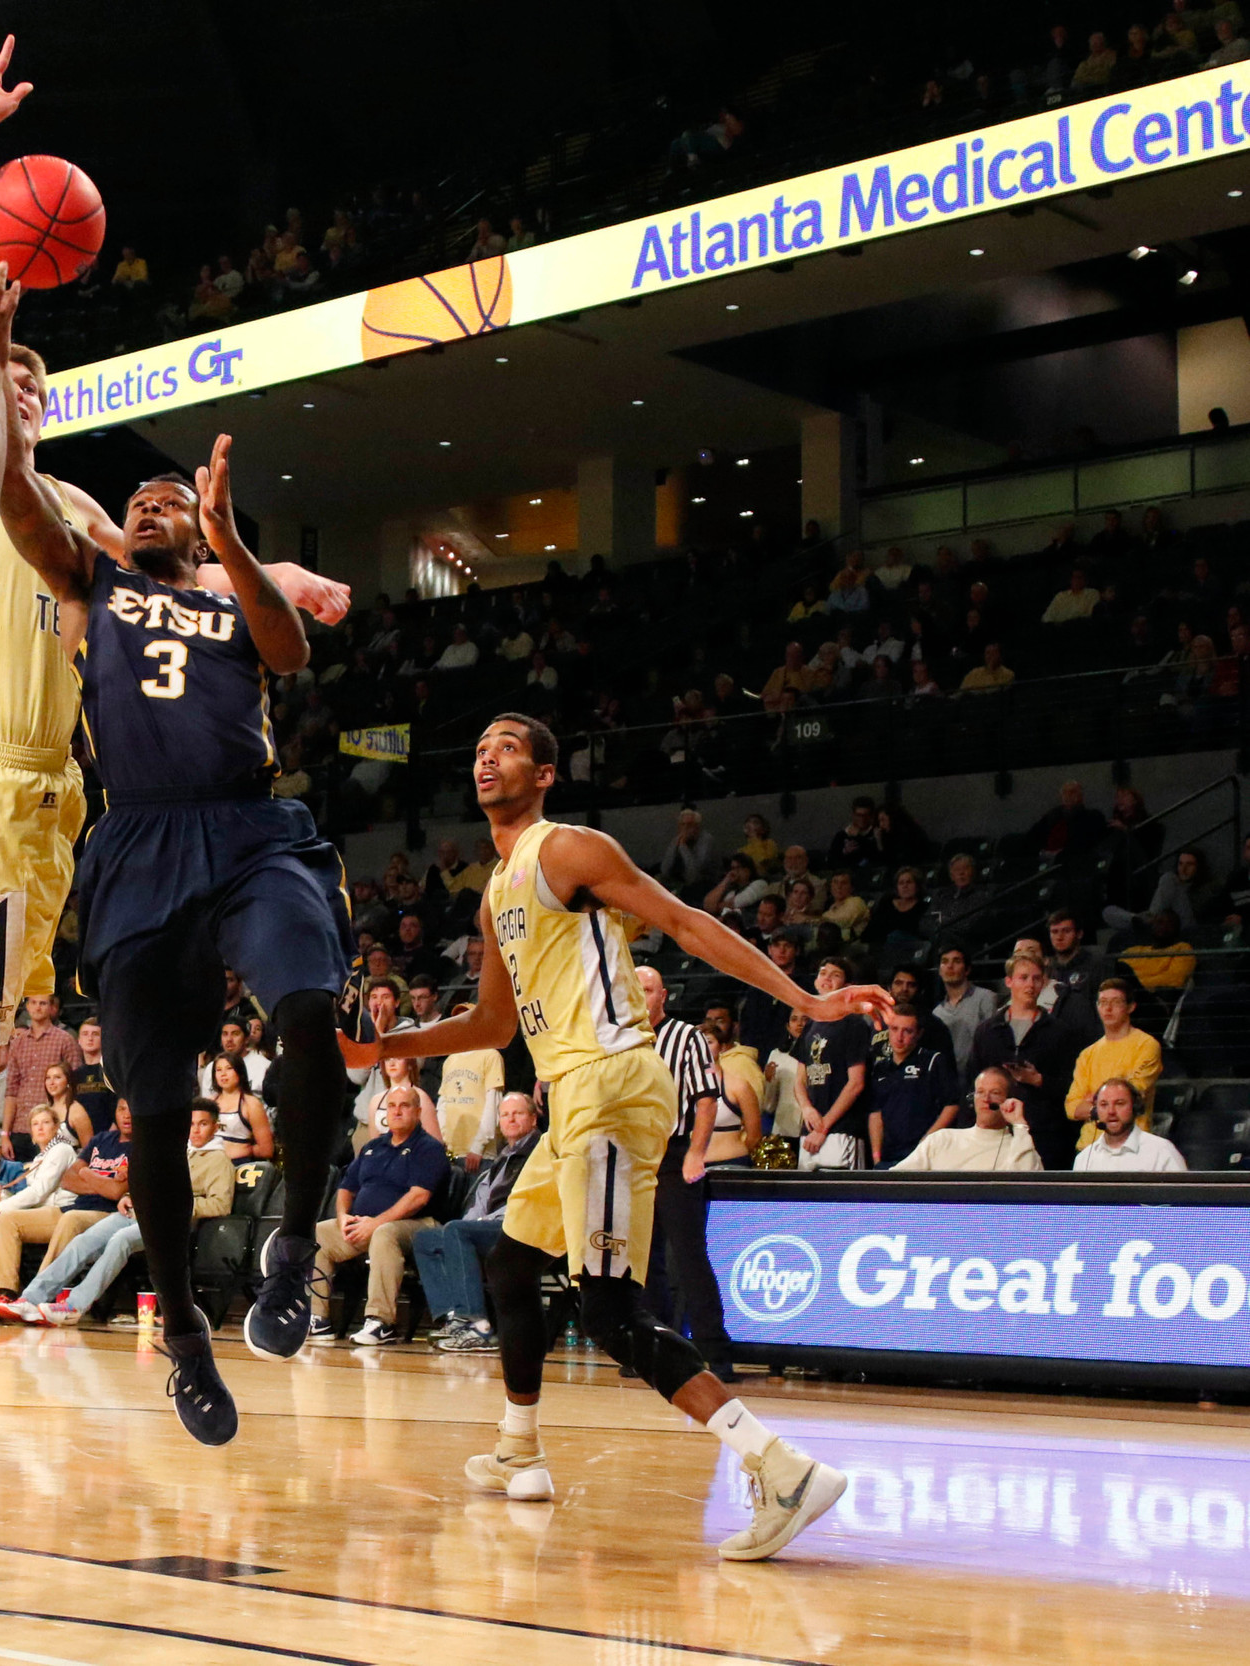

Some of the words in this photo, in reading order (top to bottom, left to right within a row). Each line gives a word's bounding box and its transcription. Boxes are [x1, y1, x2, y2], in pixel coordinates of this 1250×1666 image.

[631, 195, 825, 288] Atlanta
[838, 115, 1078, 238] Medical
[1090, 80, 1250, 173] Cent
[41, 363, 178, 427] Athletics
[188, 339, 243, 386] GT
[107, 586, 236, 642] ETSU
[141, 640, 188, 699] 3
[796, 722, 820, 738] 109
[520, 1000, 549, 1037] CH
[236, 1164, 263, 1187] GT
[589, 1230, 626, 1255] GT
[740, 1250, 814, 1309] Kroger
[837, 1234, 1085, 1315] Great
[1101, 1240, 1250, 1321] foo
